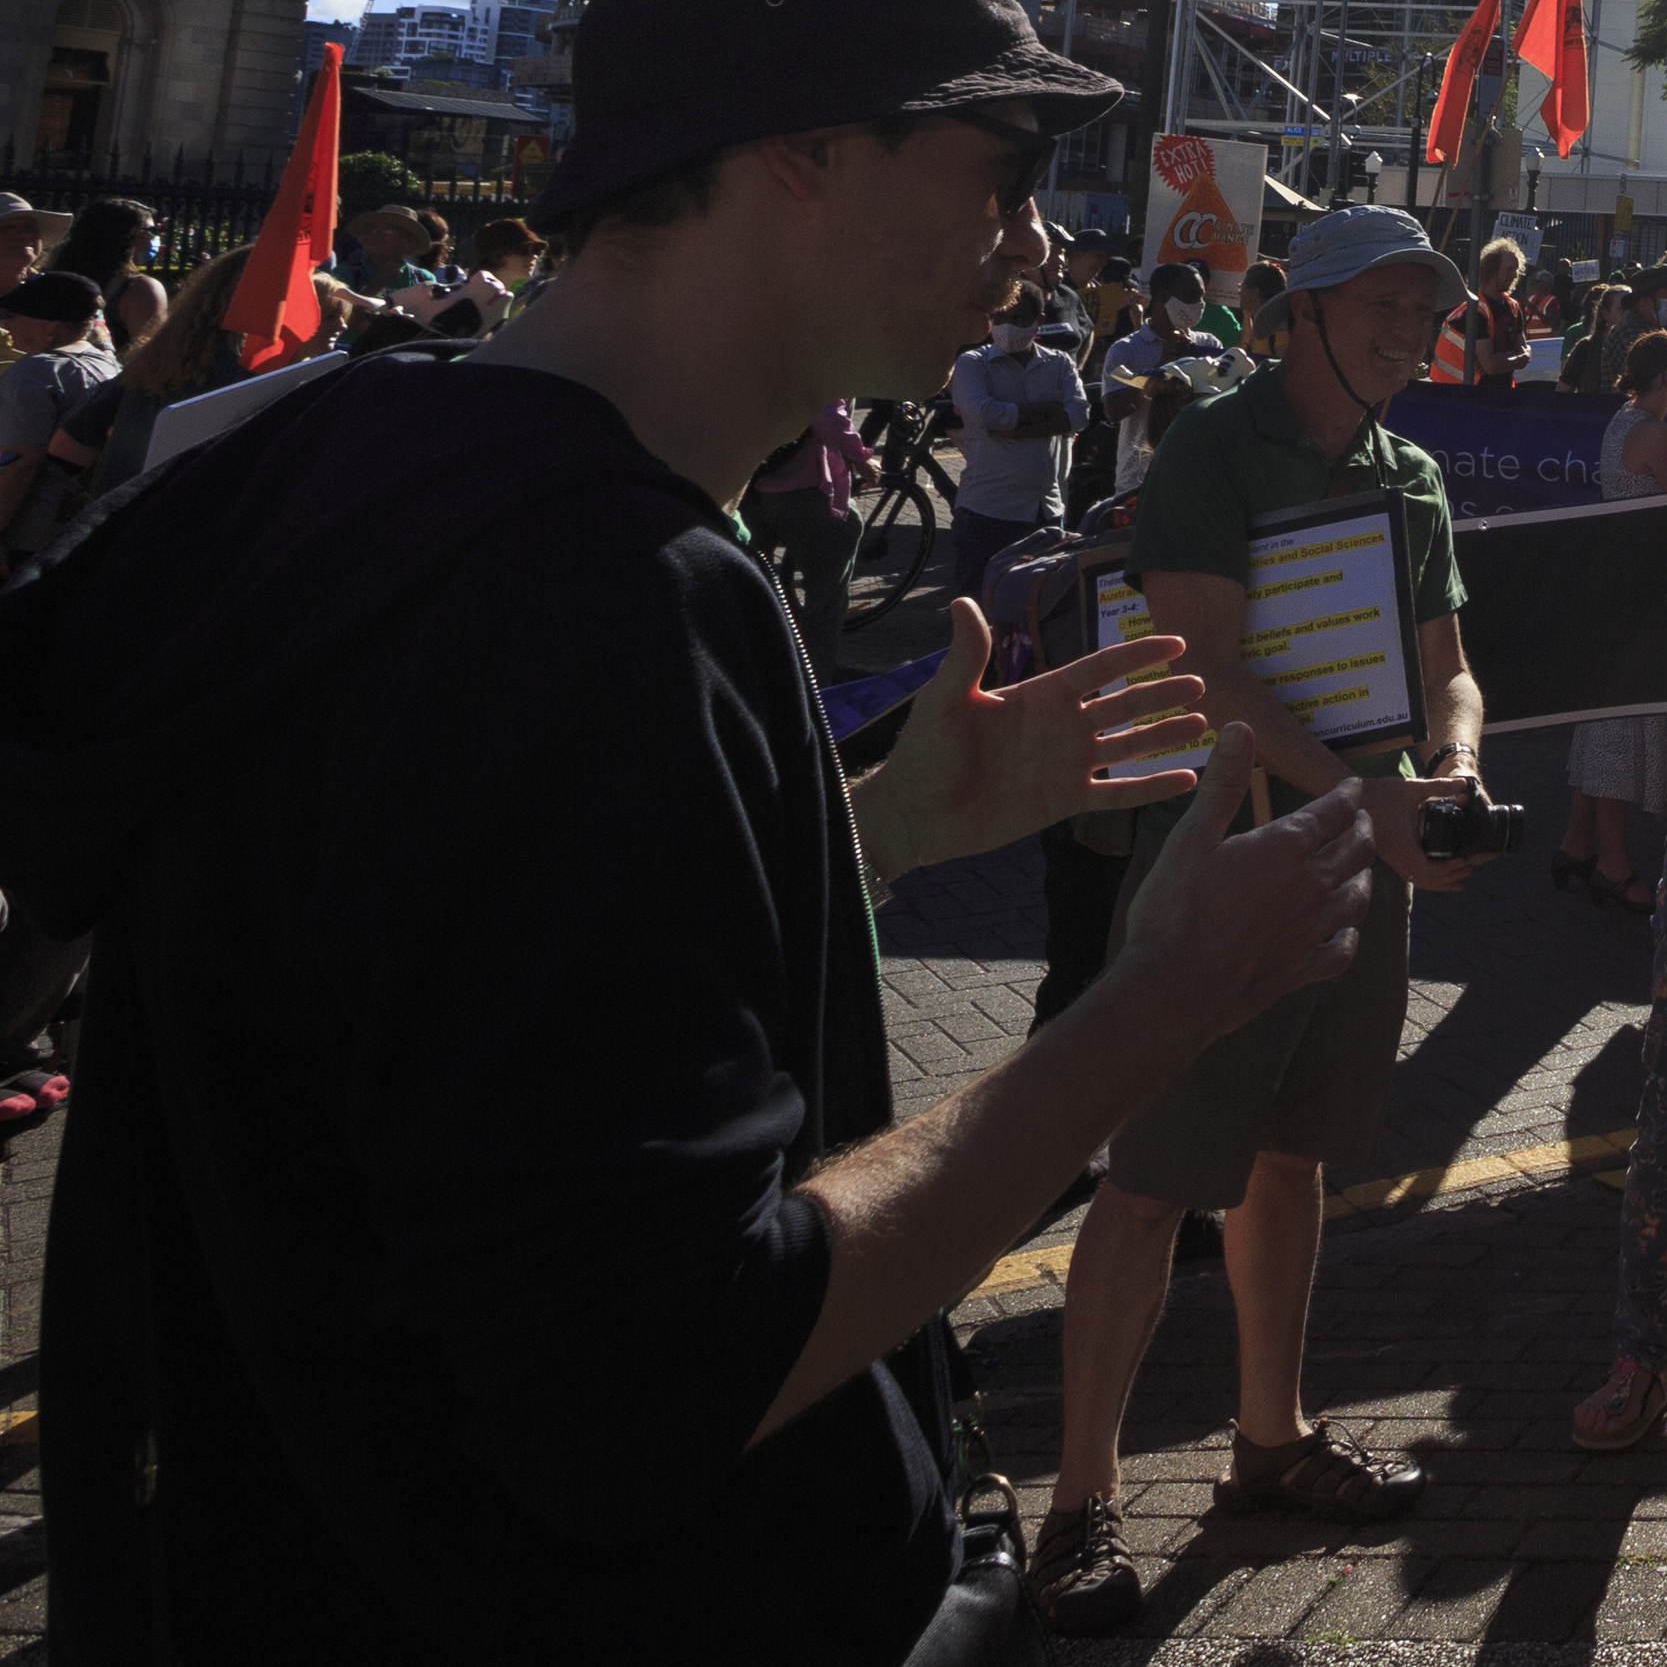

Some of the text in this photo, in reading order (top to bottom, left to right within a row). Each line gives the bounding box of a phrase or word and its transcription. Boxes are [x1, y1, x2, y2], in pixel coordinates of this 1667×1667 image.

[1159, 140, 1207, 168] EXTRA
[1174, 158, 1209, 185] HOT!
[1501, 214, 1534, 230] CLIMATE
[1278, 549, 1298, 563] and
[1301, 543, 1333, 559] Social
[1336, 533, 1385, 551] Sciences
[1281, 538, 1294, 548] the
[1265, 577, 1320, 597] participate
[1323, 570, 1344, 584] and
[1101, 608, 1120, 618] Year
[1128, 617, 1152, 627] How
[1257, 627, 1292, 643] beliefs
[1294, 622, 1314, 636] and
[1316, 615, 1351, 630] values
[1353, 608, 1380, 622] work
[1264, 641, 1290, 657] goal.
[1279, 665, 1334, 684] responses
[1337, 661, 1347, 671] to
[1350, 654, 1386, 669] issues
[1322, 692, 1356, 706] action
[1359, 687, 1370, 699] in
[1190, 739, 1200, 748] to
